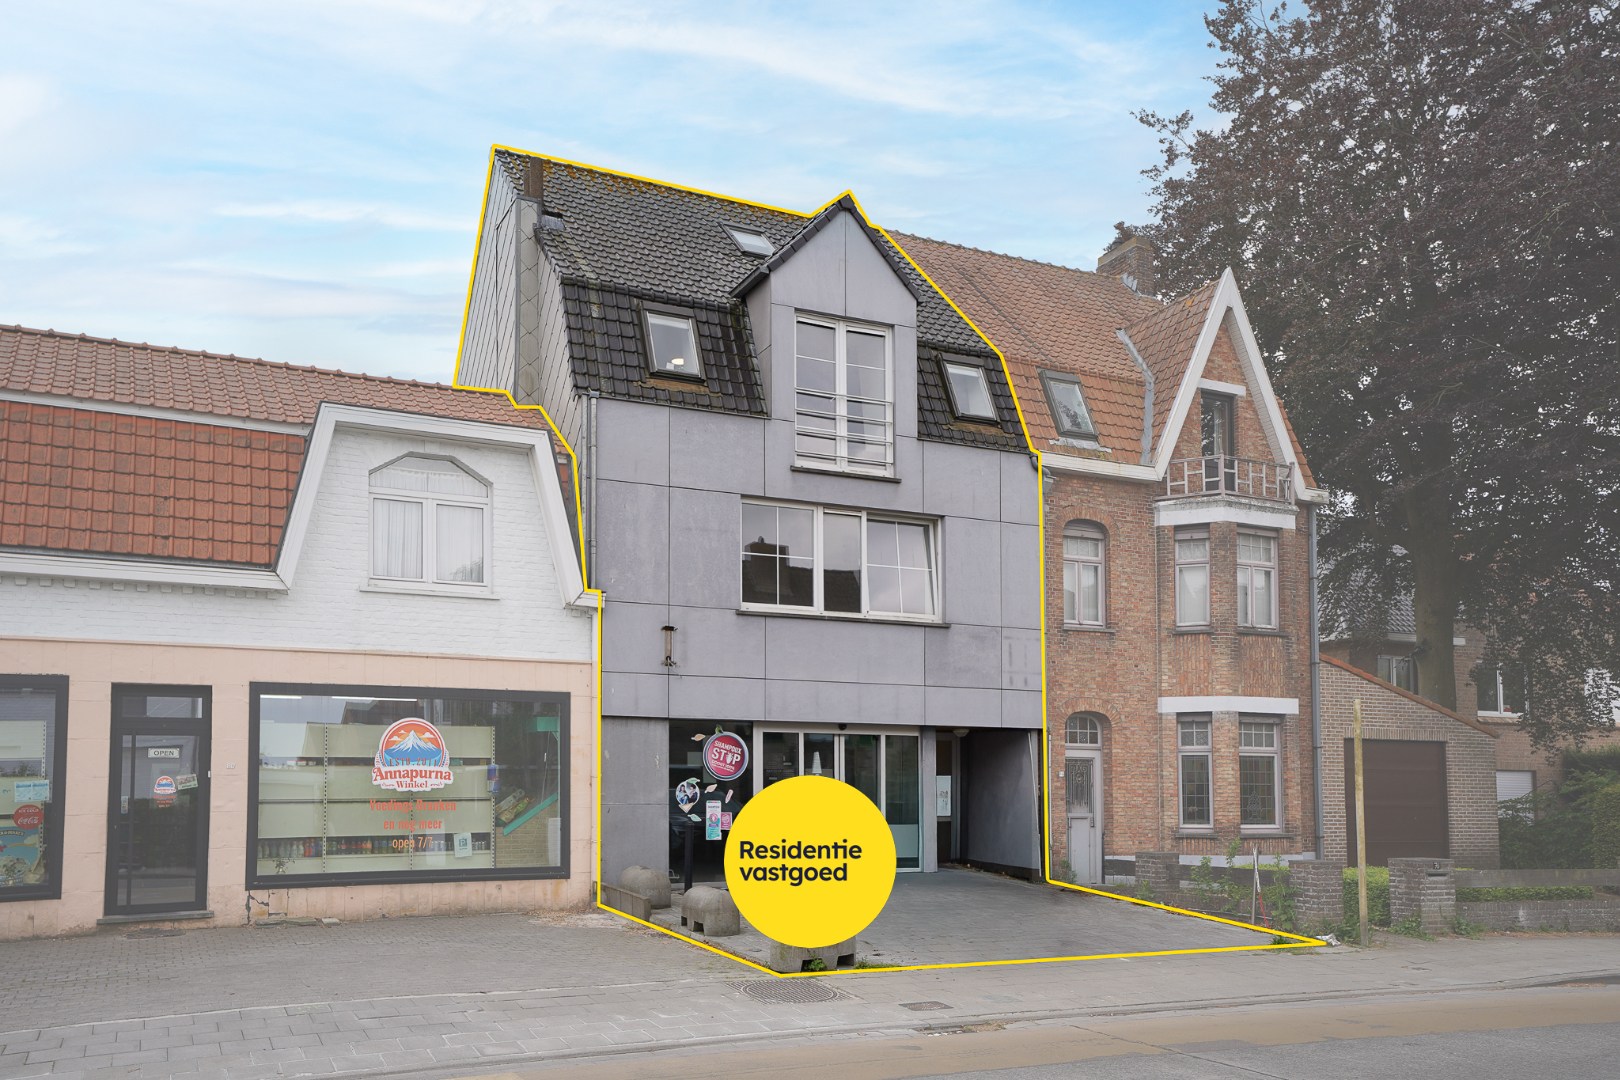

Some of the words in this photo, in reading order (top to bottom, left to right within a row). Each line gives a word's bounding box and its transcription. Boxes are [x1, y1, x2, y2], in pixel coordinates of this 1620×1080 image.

[711, 747, 741, 765] STOP
[372, 767, 452, 782] Annapurna
[396, 780, 428, 789] Winkel
[369, 799, 413, 813] Voedings
[415, 799, 457, 811] Dranken
[383, 820, 395, 830] en
[398, 820, 416, 833] nog
[418, 820, 442, 830] meer
[392, 838, 415, 852] open
[417, 836, 433, 849] 7/7
